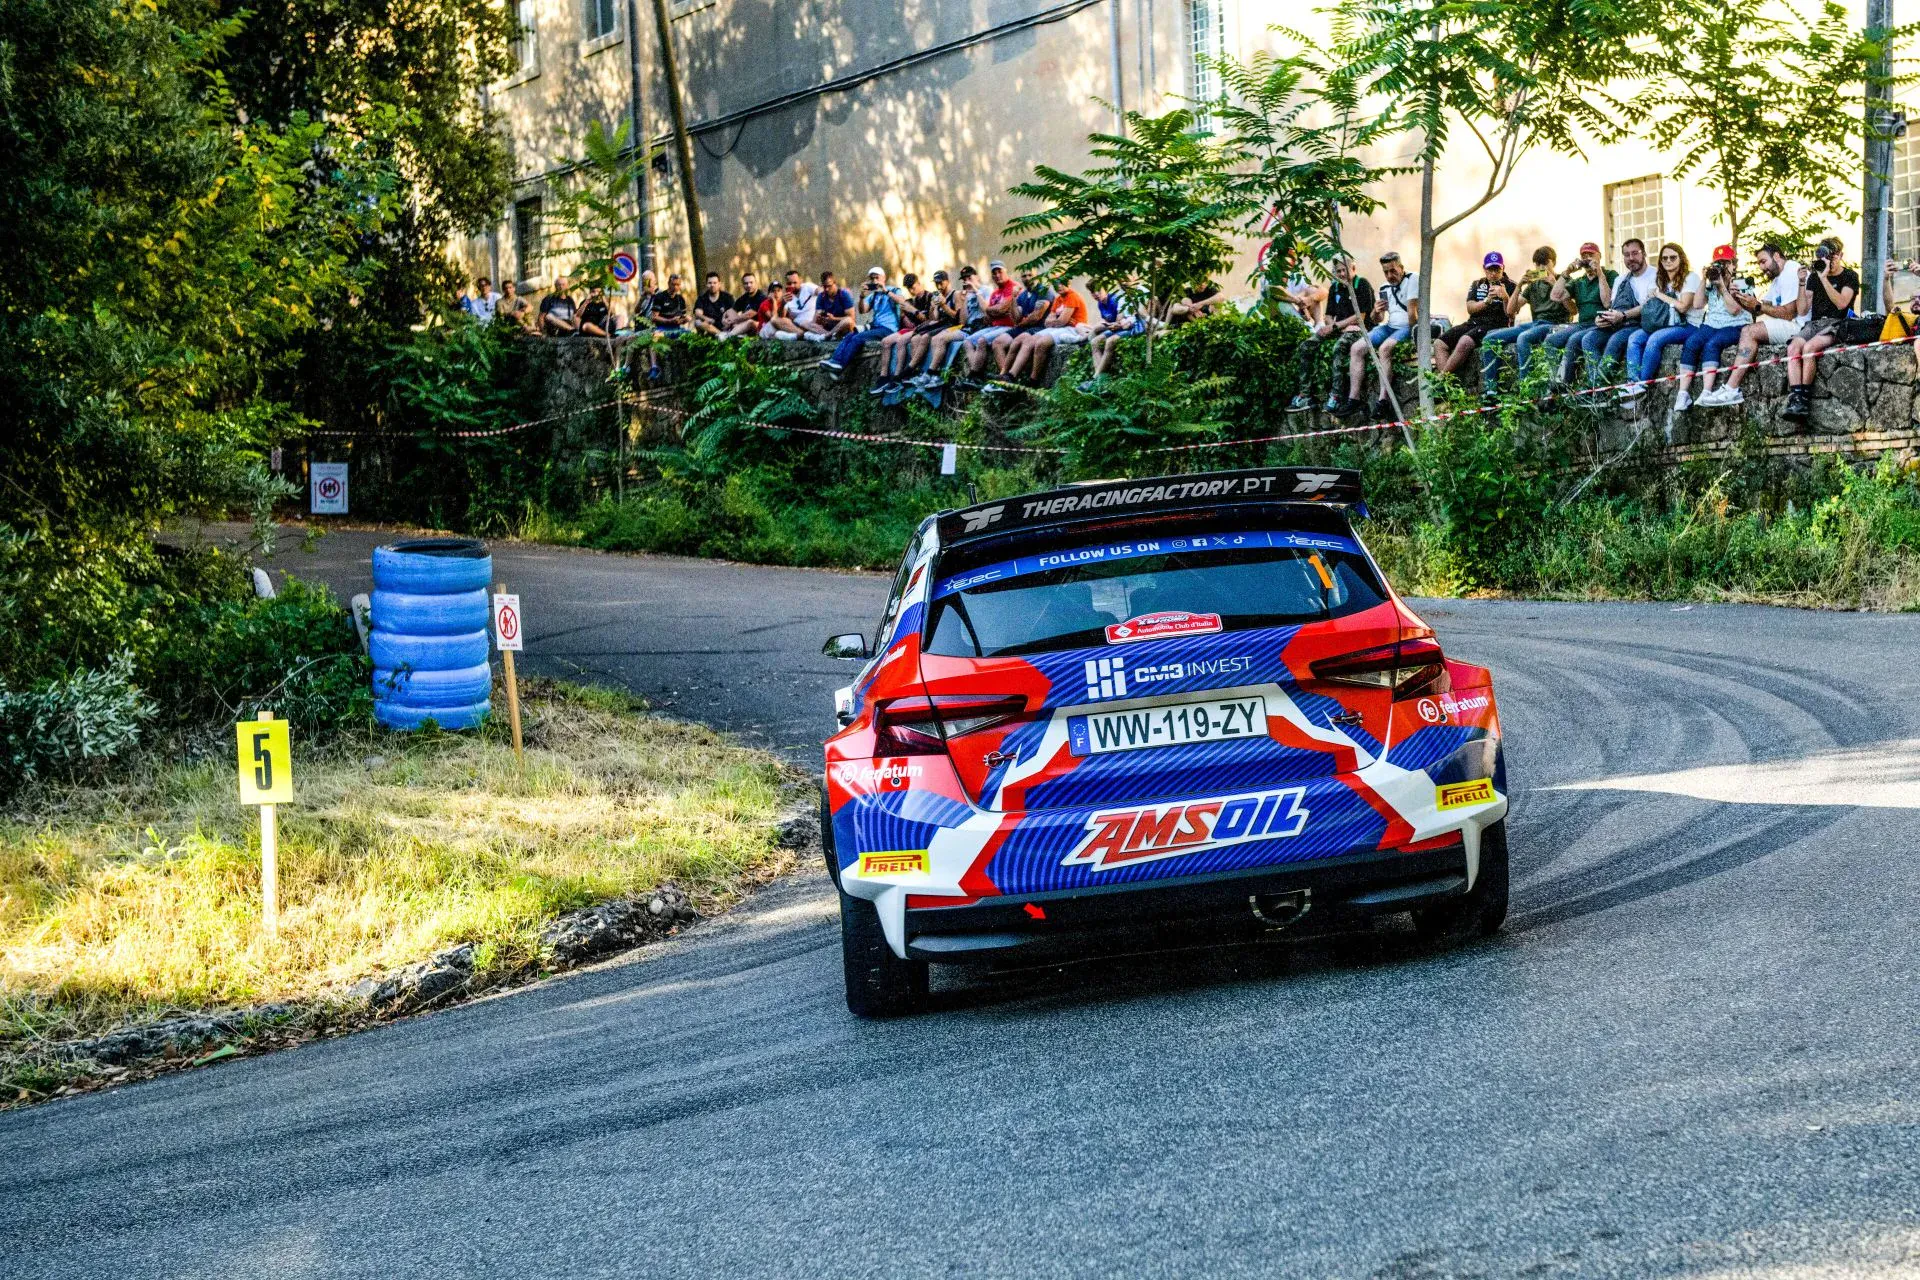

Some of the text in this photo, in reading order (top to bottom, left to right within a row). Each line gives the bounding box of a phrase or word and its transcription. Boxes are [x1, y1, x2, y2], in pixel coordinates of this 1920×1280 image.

[1022, 476, 1276, 519] THERACINGFACTORY.PT
[1039, 542, 1160, 567] FOLLOW US ON
[1308, 554, 1333, 589] 1
[1174, 622, 1190, 630] Club
[1135, 656, 1253, 683] CM3 INVEST
[1439, 696, 1489, 714] ferratum
[1092, 701, 1257, 749] WW-119-ZY
[1076, 738, 1084, 748] F
[252, 733, 273, 791] 5
[1441, 783, 1491, 806] PIRELLI
[1074, 791, 1306, 867] AMSOIL
[864, 854, 922, 873] PIRELLI
